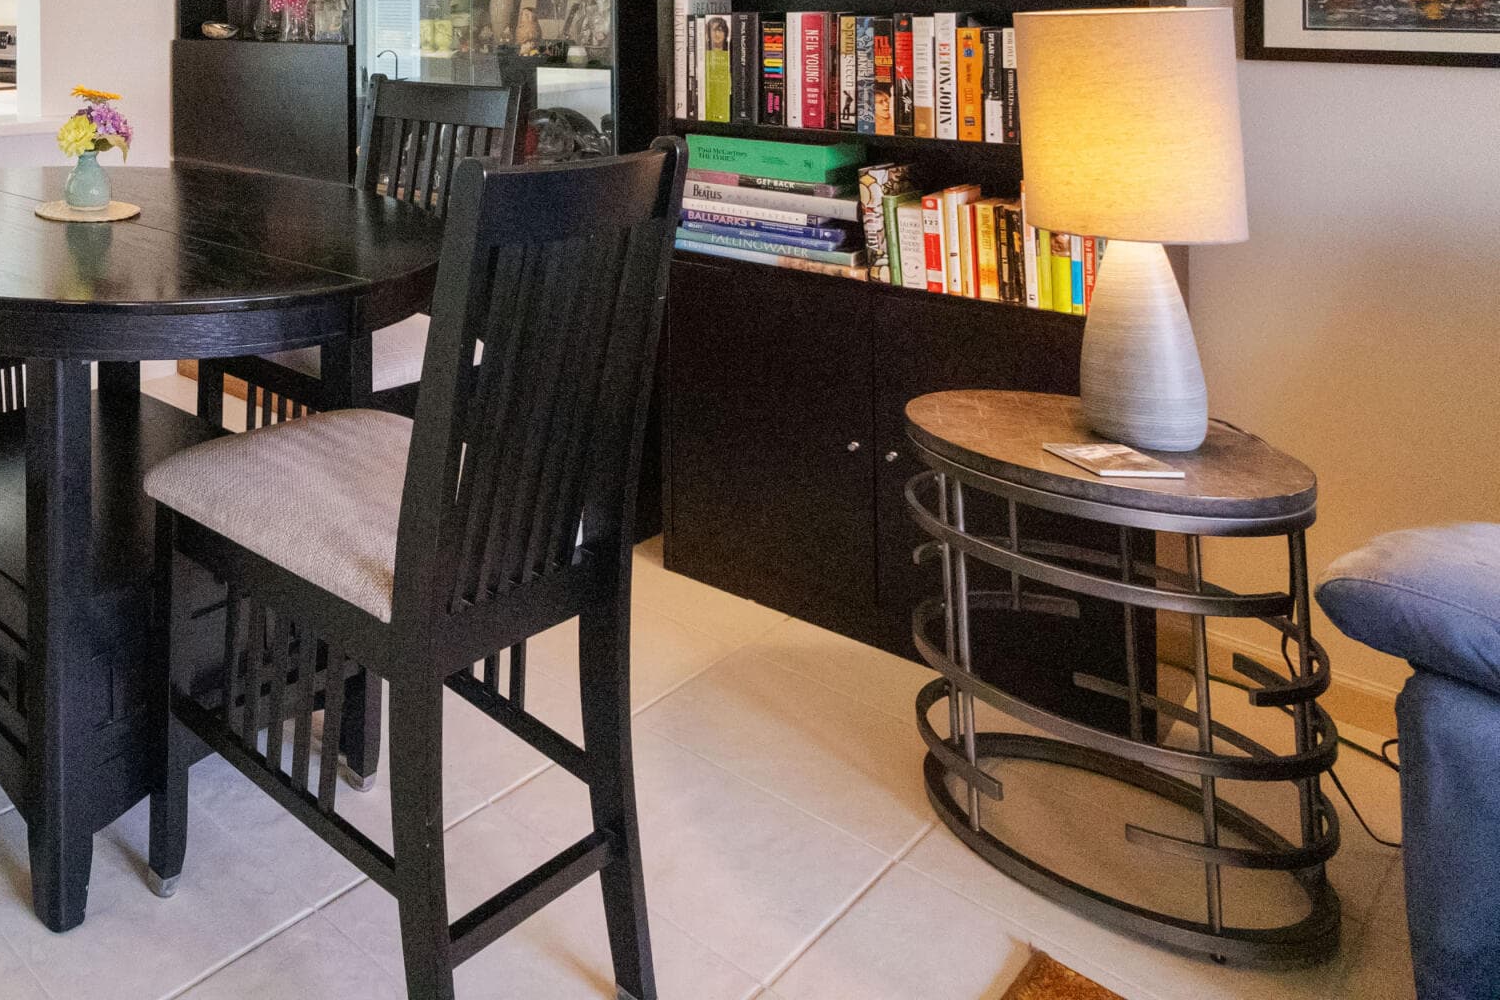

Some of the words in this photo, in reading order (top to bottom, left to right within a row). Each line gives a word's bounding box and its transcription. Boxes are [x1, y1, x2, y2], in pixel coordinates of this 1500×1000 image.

[674, 7, 685, 53] BEATLES
[805, 29, 819, 51] NEIL
[763, 35, 784, 79] SHOUT!
[805, 53, 819, 84] YOUNG
[841, 22, 856, 88] Springsteen
[857, 50, 868, 79] JANIS
[939, 42, 952, 86] ELTON
[1007, 69, 1015, 107] CHRONICLES
[939, 86, 953, 126] JOHN
[698, 146, 711, 155] Paul
[712, 147, 748, 158] McCartney
[692, 184, 723, 200] BEATLES
[756, 177, 771, 186] GET
[773, 178, 796, 190] BACK
[687, 210, 748, 227] BALLPARKS
[710, 235, 808, 258] FALLINGWATER
